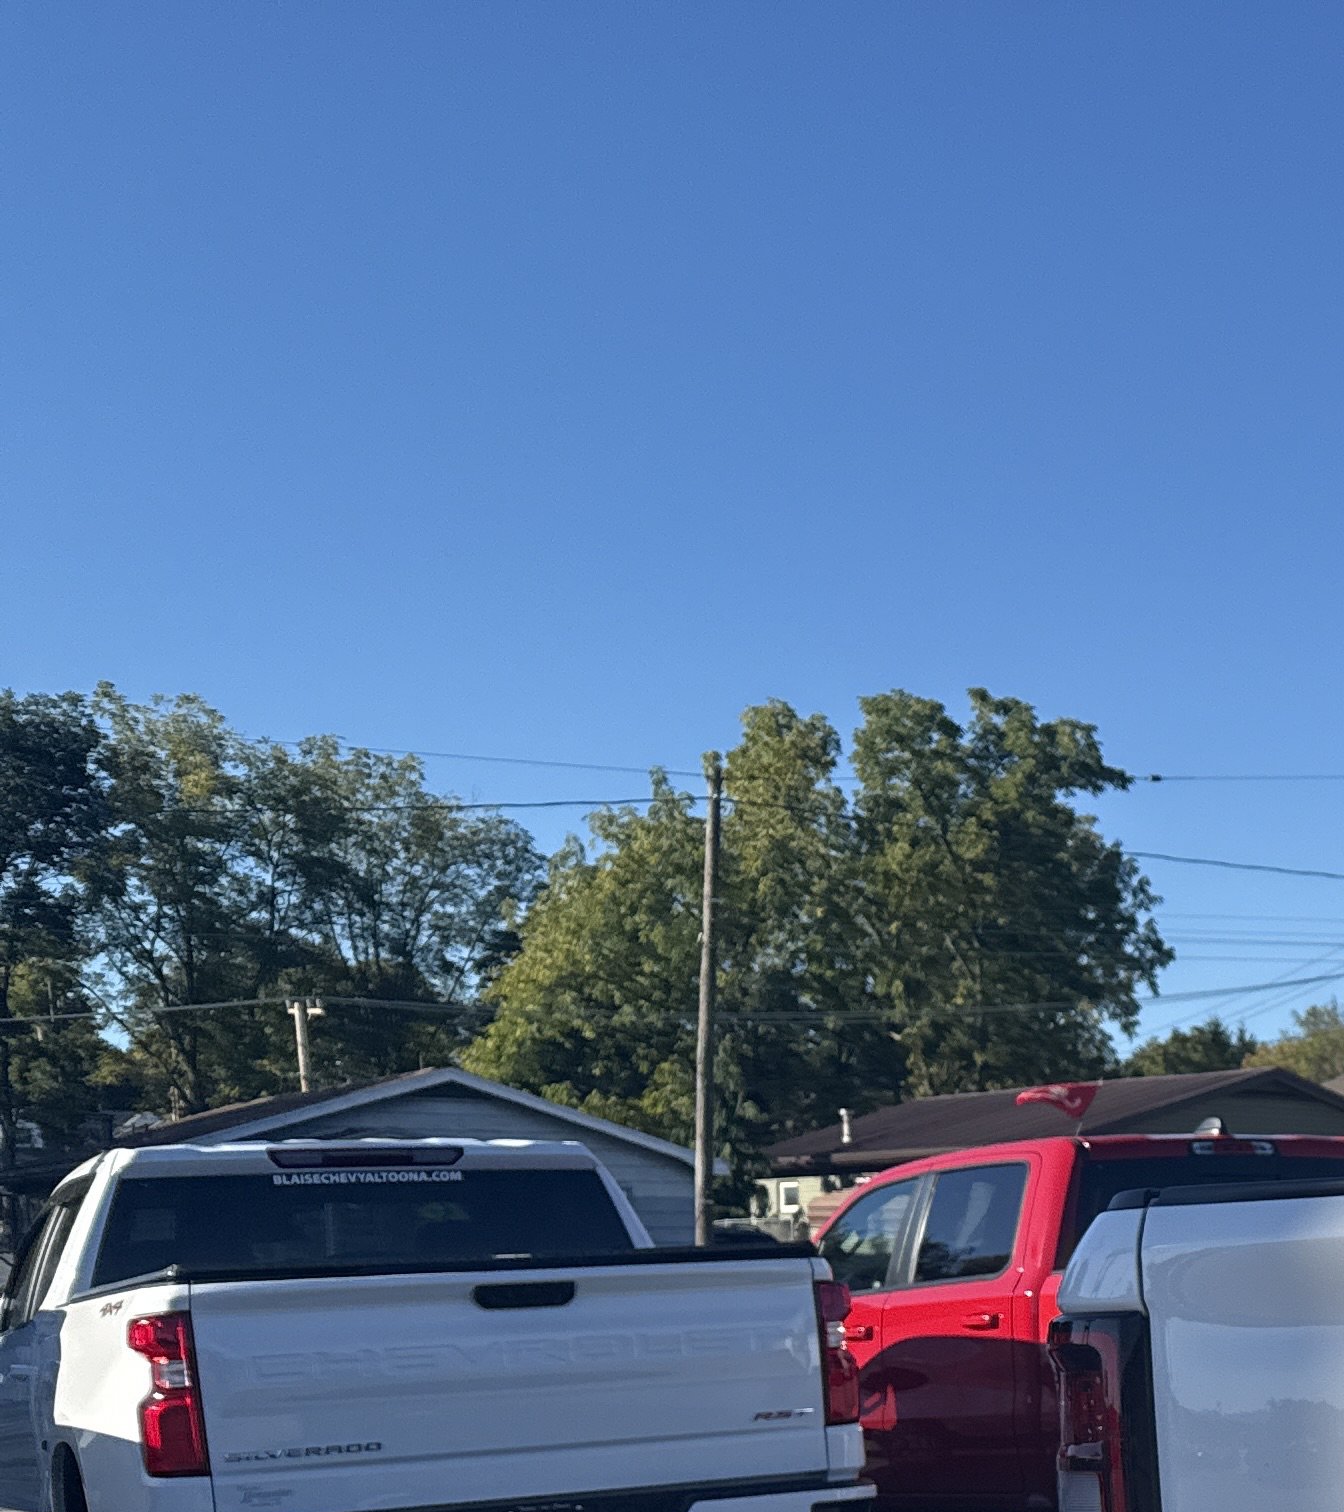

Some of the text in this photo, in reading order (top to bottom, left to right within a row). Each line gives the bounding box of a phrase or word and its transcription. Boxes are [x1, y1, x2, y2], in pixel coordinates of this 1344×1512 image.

[273, 1170, 462, 1185] BLAISECHEVYALTOONA.COM
[246, 1327, 800, 1382] CHEVROLET
[224, 1442, 382, 1463] SILVERADO
